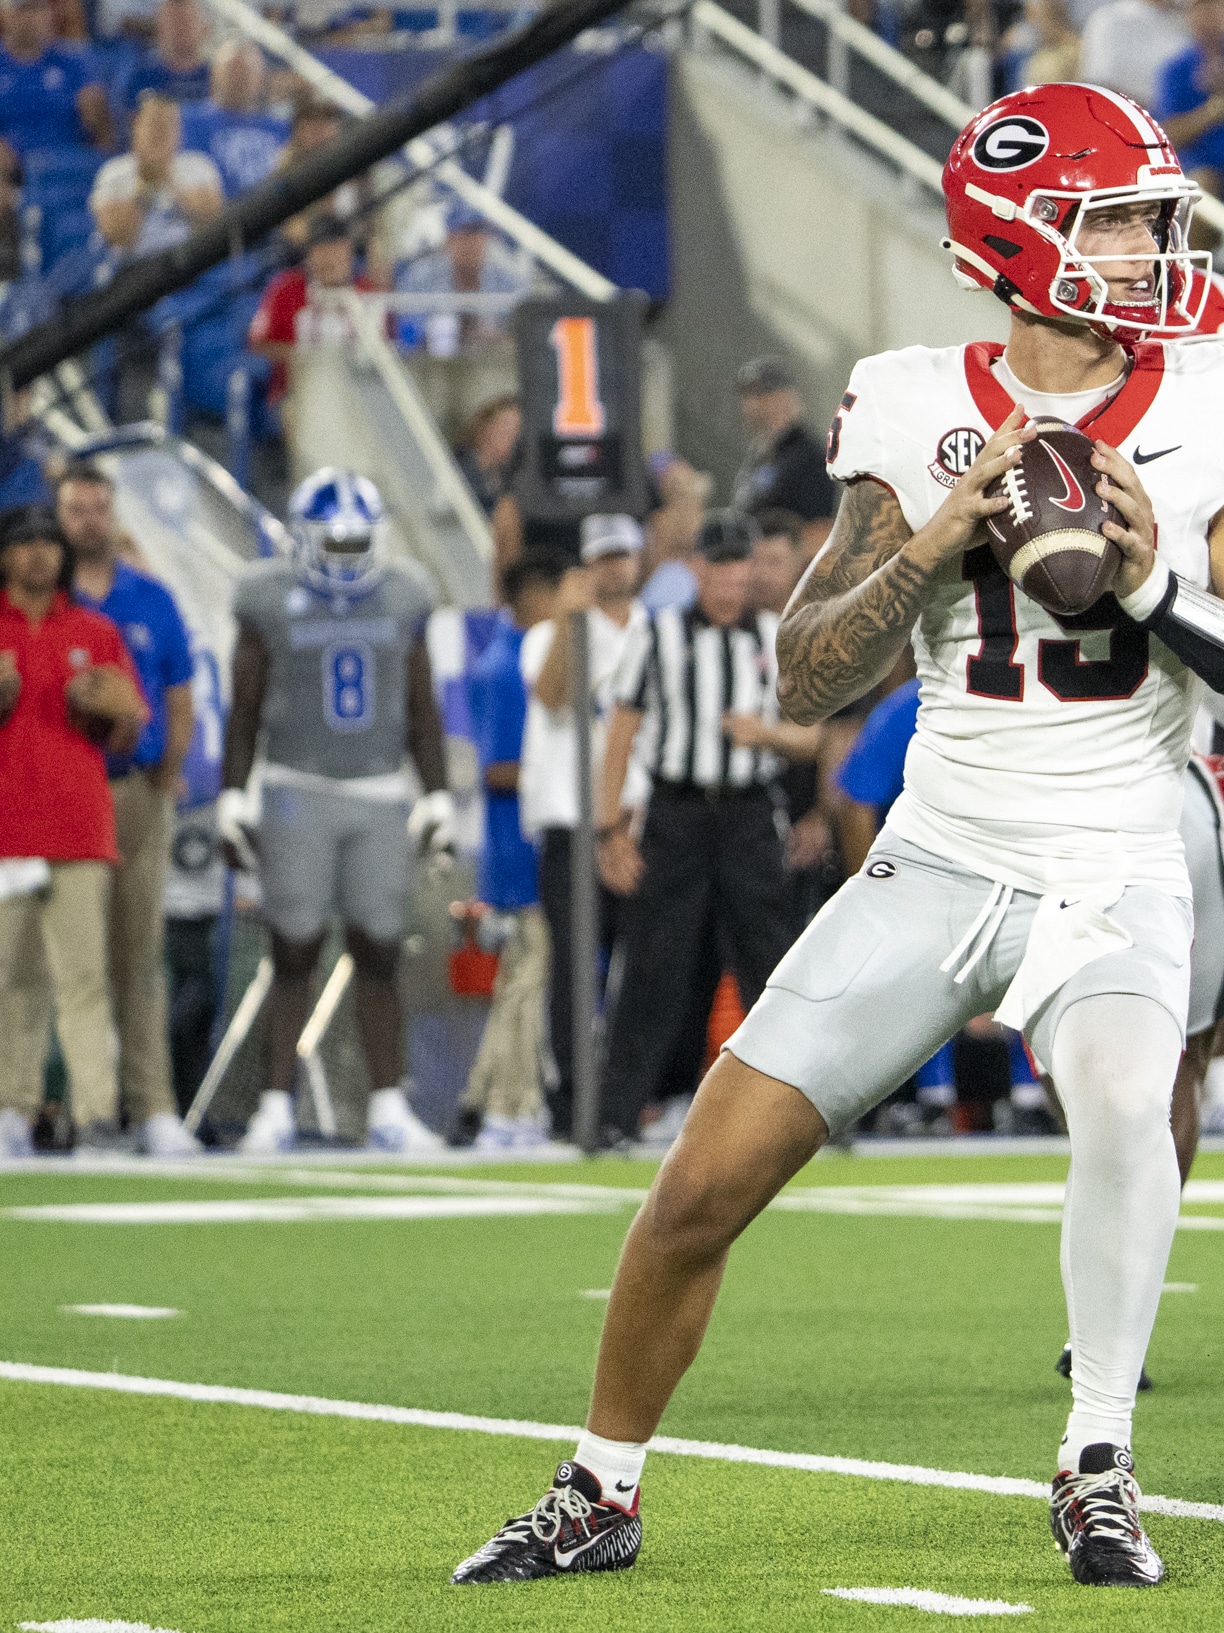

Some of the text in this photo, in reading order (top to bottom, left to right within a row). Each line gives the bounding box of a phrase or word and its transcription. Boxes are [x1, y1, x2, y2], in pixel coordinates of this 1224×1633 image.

[974, 117, 1047, 169] G
[549, 316, 606, 437] 1
[941, 430, 983, 474] SEC
[325, 645, 374, 729] 8
[866, 861, 896, 878] G
